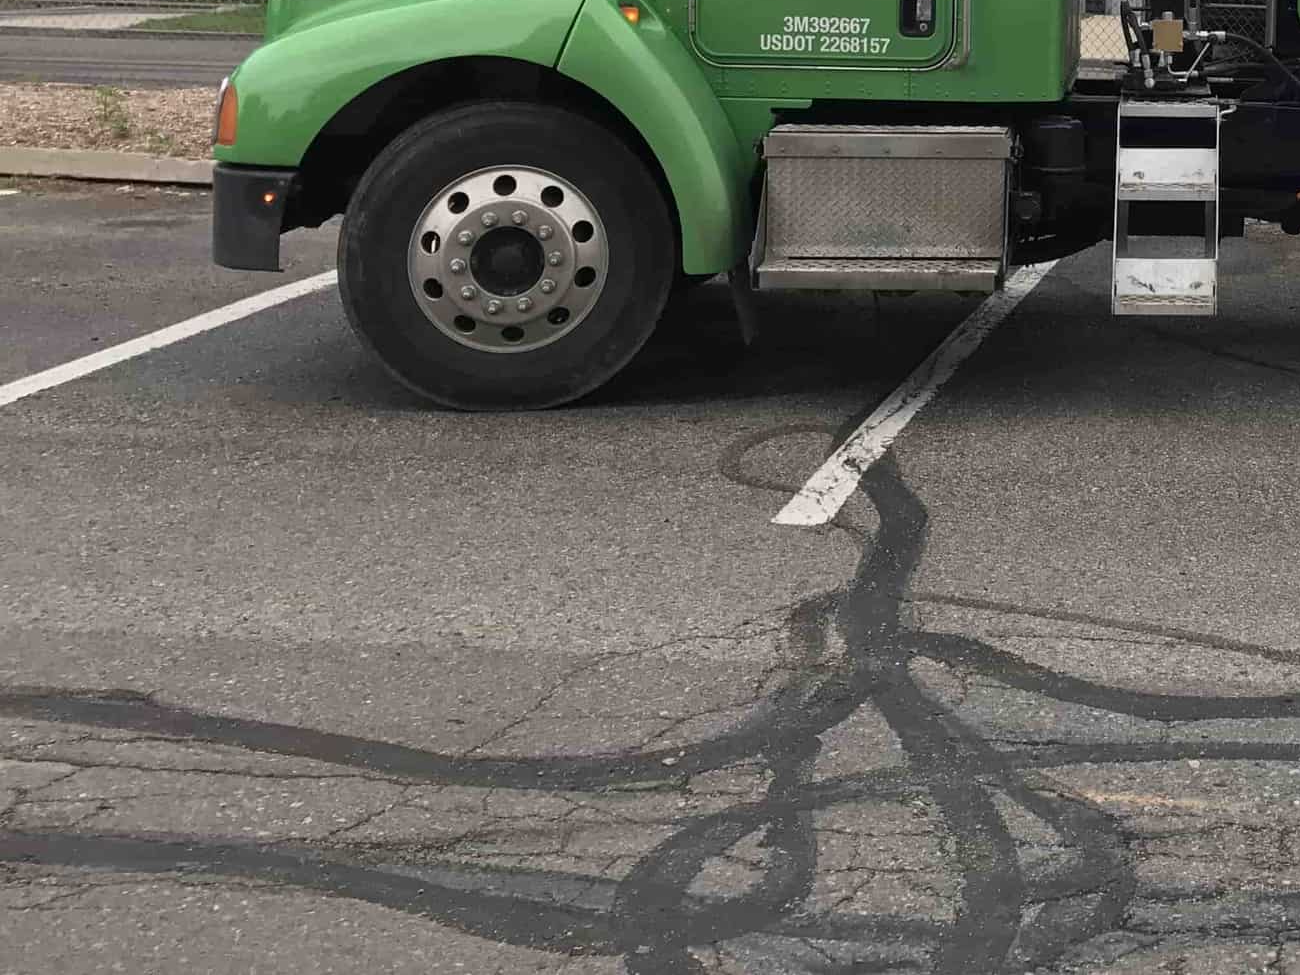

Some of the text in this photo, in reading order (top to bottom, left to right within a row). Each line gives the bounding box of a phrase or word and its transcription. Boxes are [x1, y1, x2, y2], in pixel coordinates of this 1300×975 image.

[783, 16, 871, 34] 3M392667
[760, 34, 891, 54] USDOT 2268157
